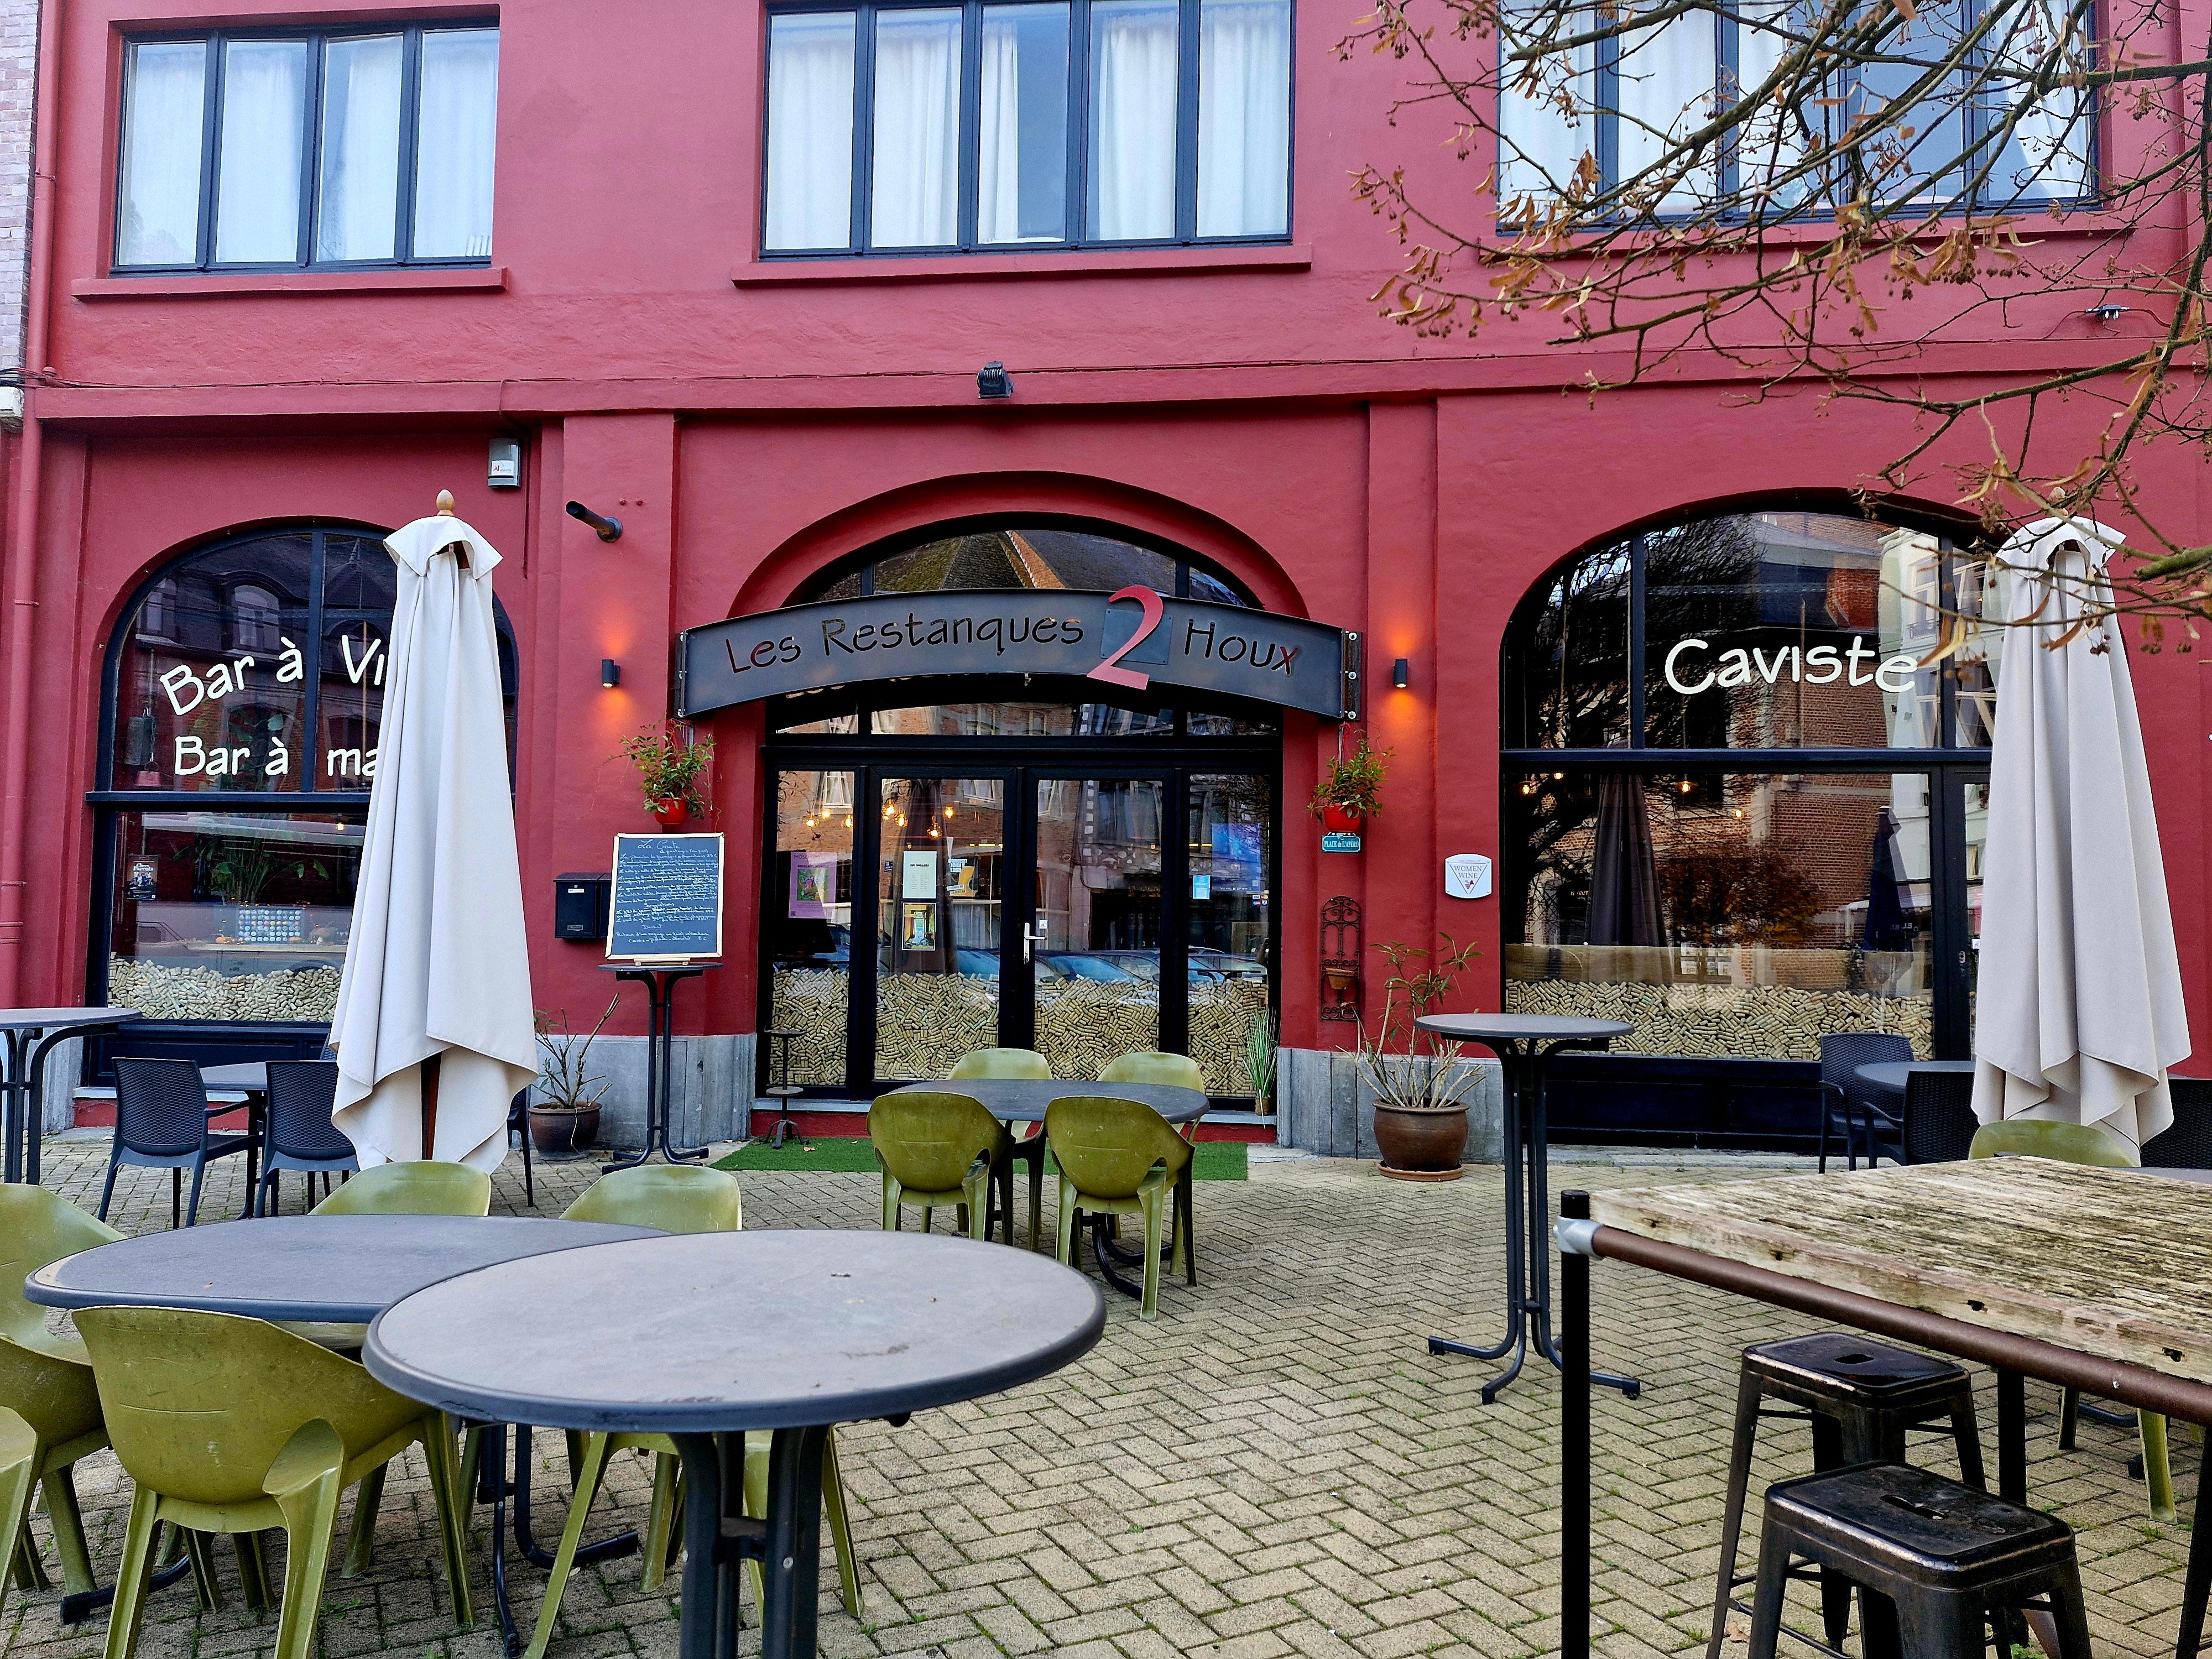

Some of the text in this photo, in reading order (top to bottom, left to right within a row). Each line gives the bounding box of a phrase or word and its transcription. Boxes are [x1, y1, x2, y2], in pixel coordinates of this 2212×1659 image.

[726, 585, 1299, 690] Les Restanques 2 Houx
[1665, 635, 1918, 695] Caviste
[160, 634, 385, 716] Bar à Vi
[174, 735, 378, 776] Bar à ma
[638, 839, 680, 849] La Carte
